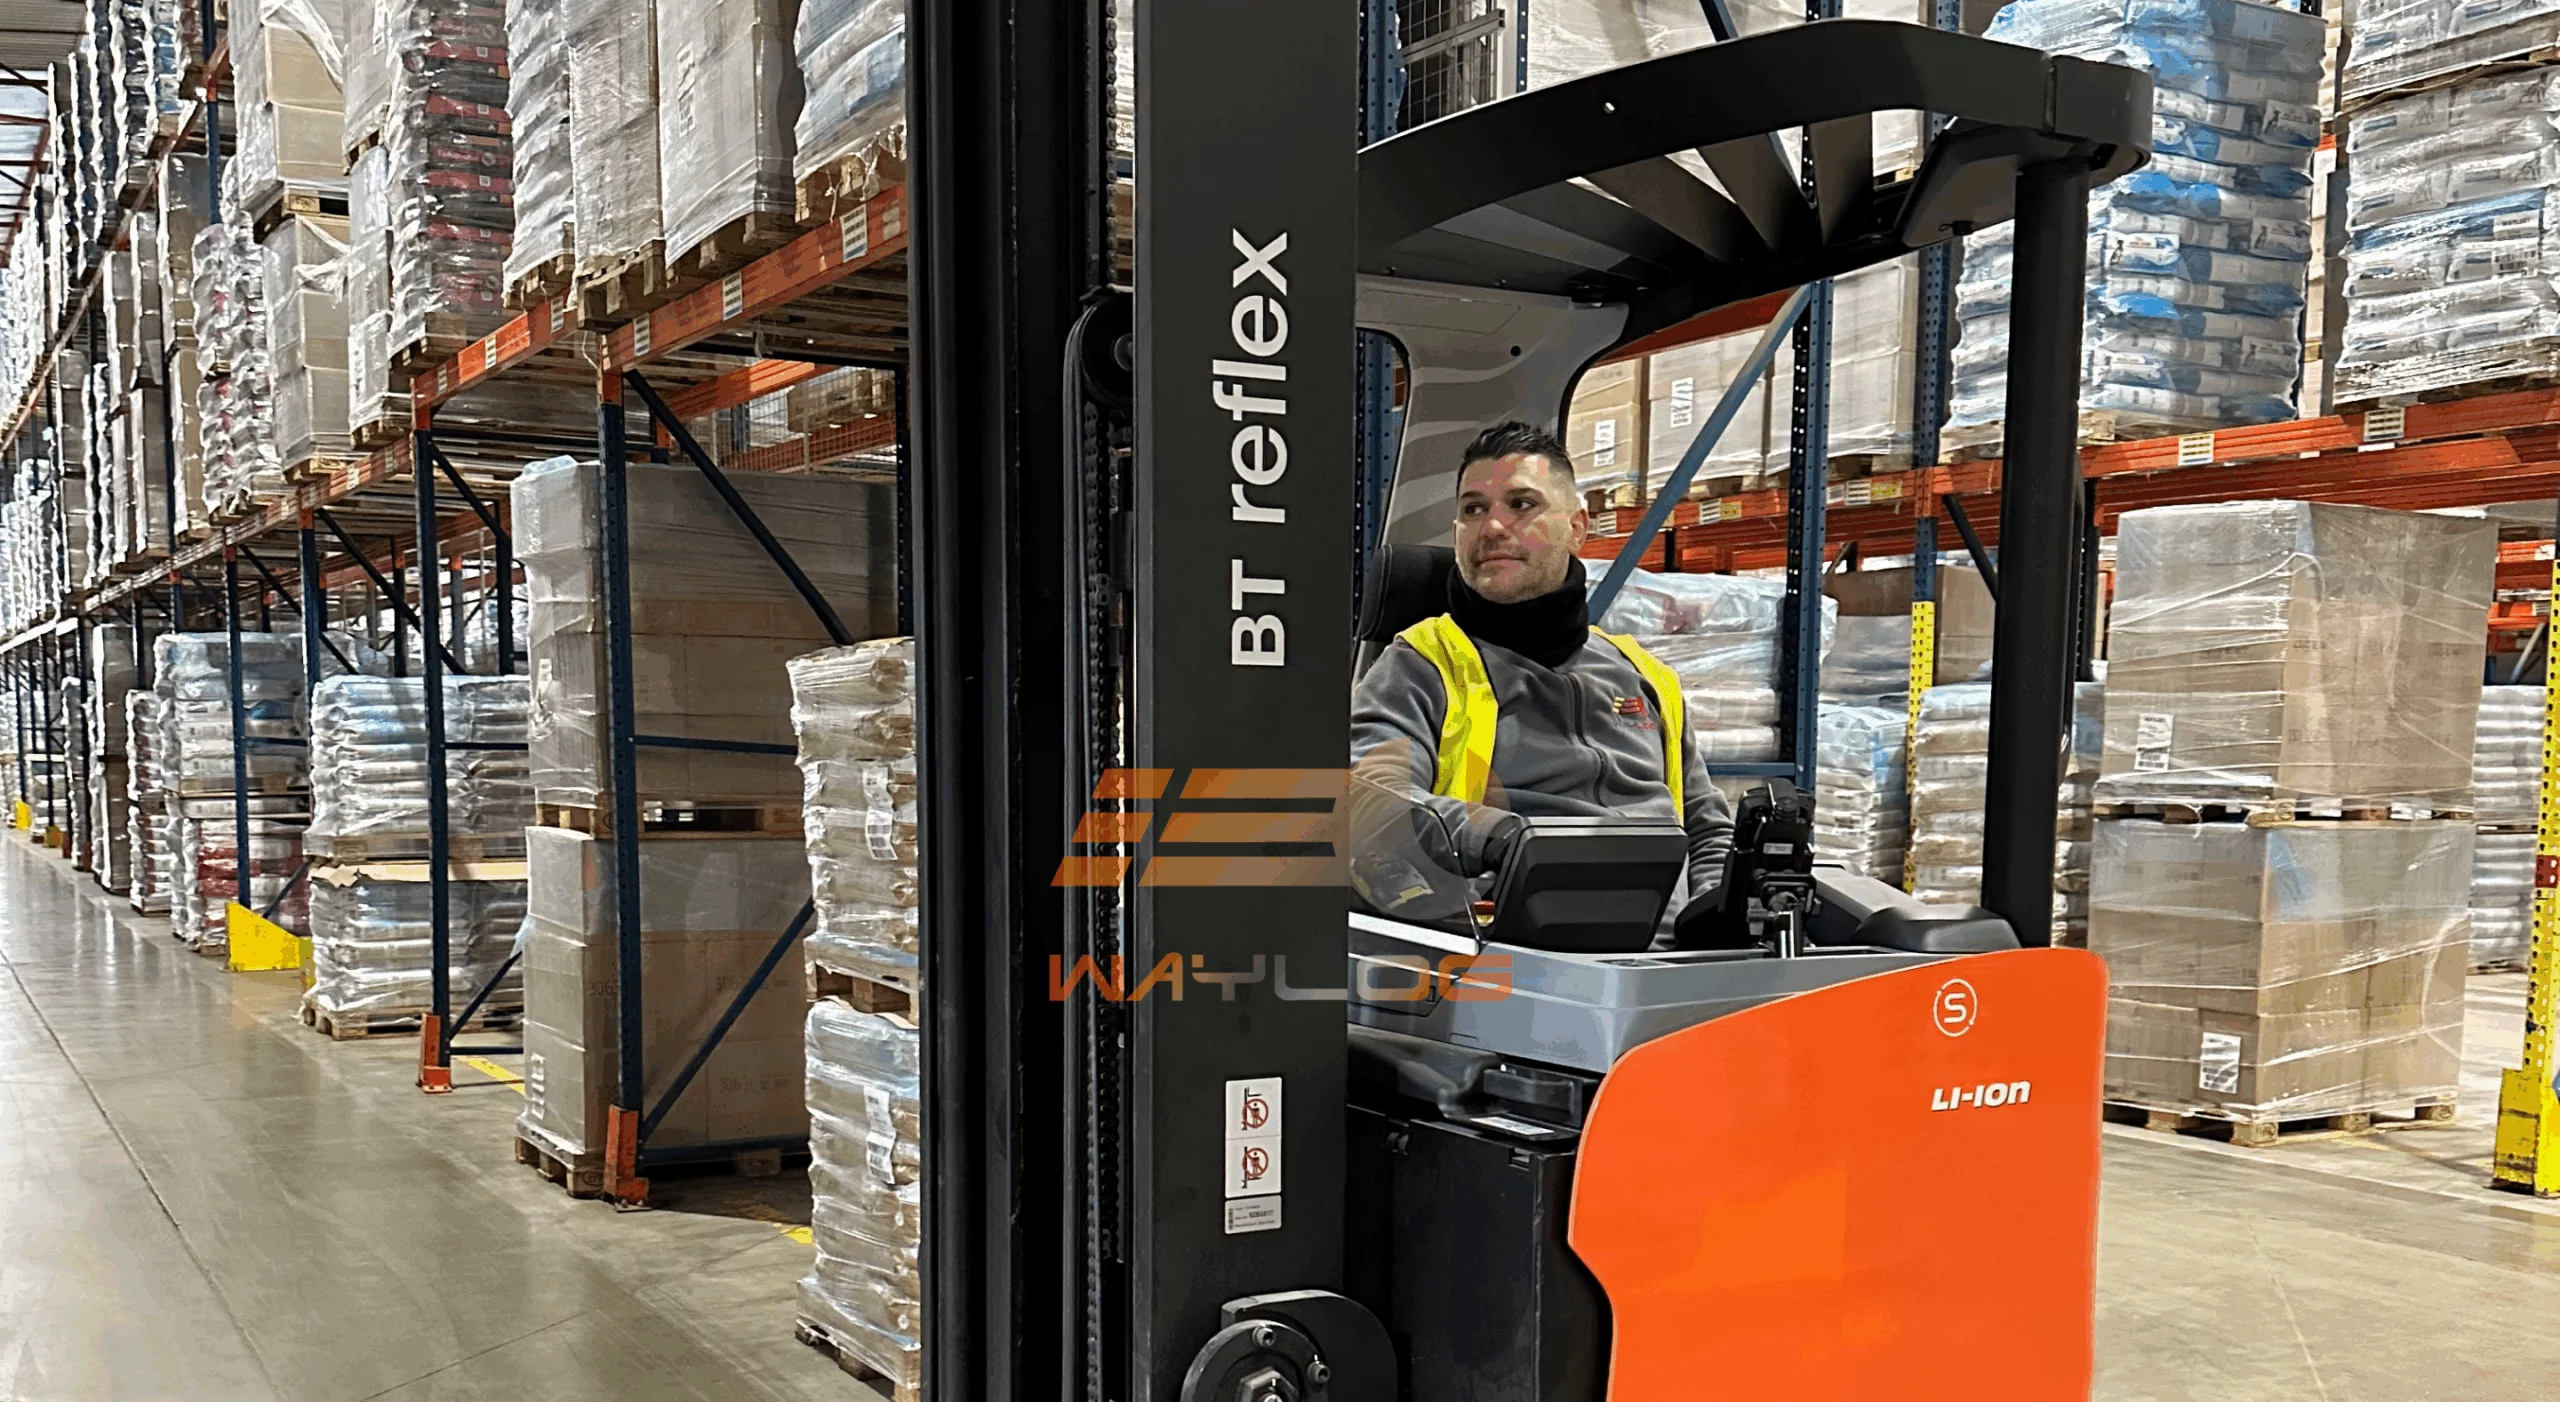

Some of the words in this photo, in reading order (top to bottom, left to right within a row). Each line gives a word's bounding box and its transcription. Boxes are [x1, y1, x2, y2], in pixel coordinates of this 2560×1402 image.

[1212, 228, 1289, 524] reflex
[1231, 558, 1286, 667] BT
[1943, 992, 1968, 1024] S
